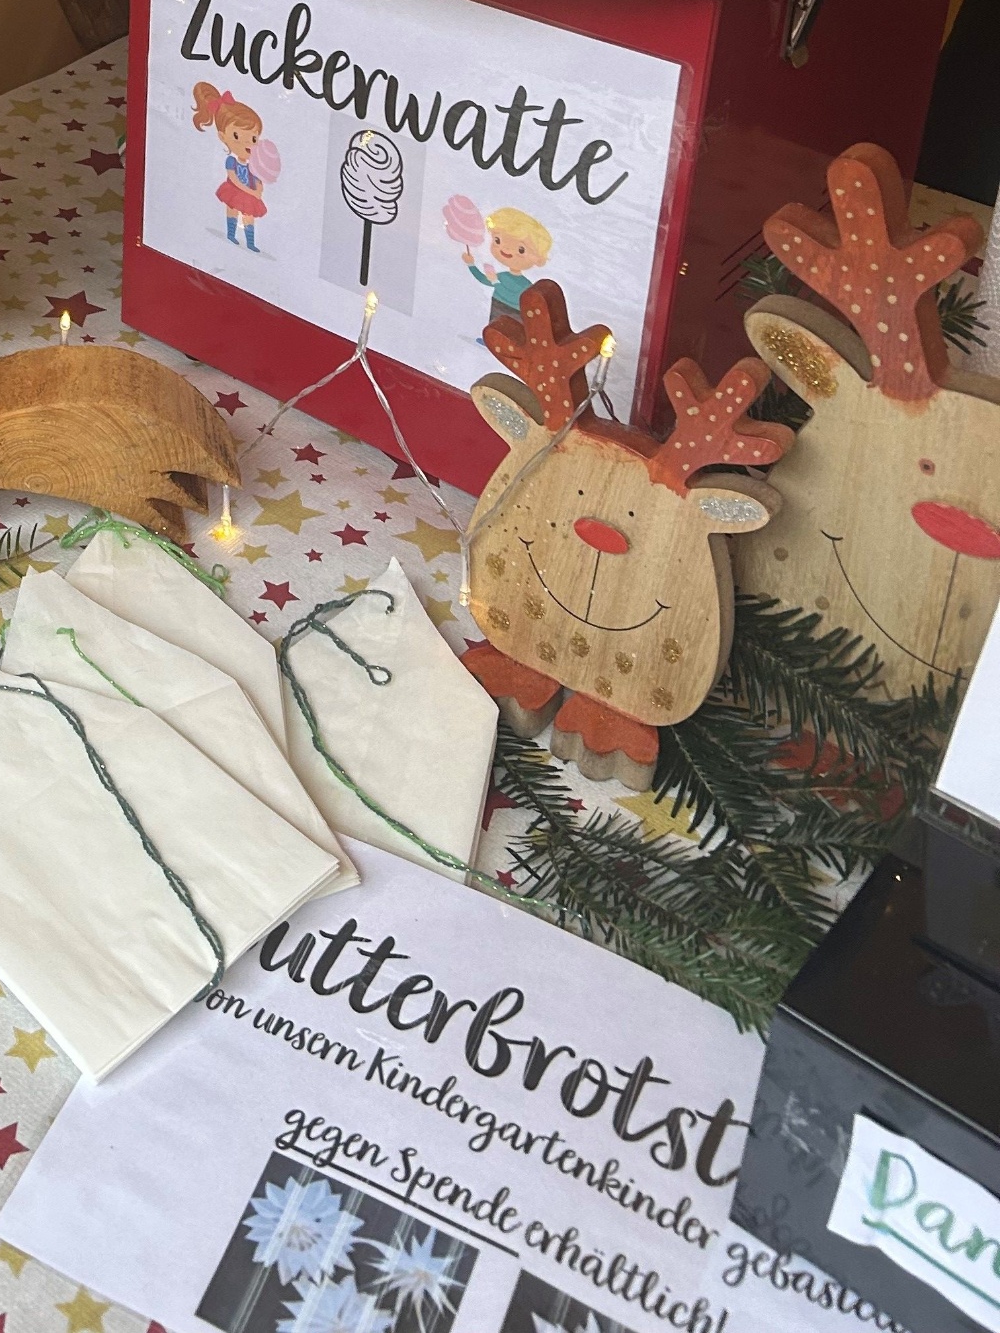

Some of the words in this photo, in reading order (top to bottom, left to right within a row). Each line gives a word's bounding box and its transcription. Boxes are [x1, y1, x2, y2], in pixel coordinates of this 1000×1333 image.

[250, 918, 754, 1187] utterbrotst
[253, 1007, 364, 1070] unsern
[365, 1048, 720, 1250] Kindergartenkinder
[275, 1109, 389, 1167] gegen
[390, 1147, 521, 1233] Spende
[524, 1222, 728, 1333] erhältlich!
